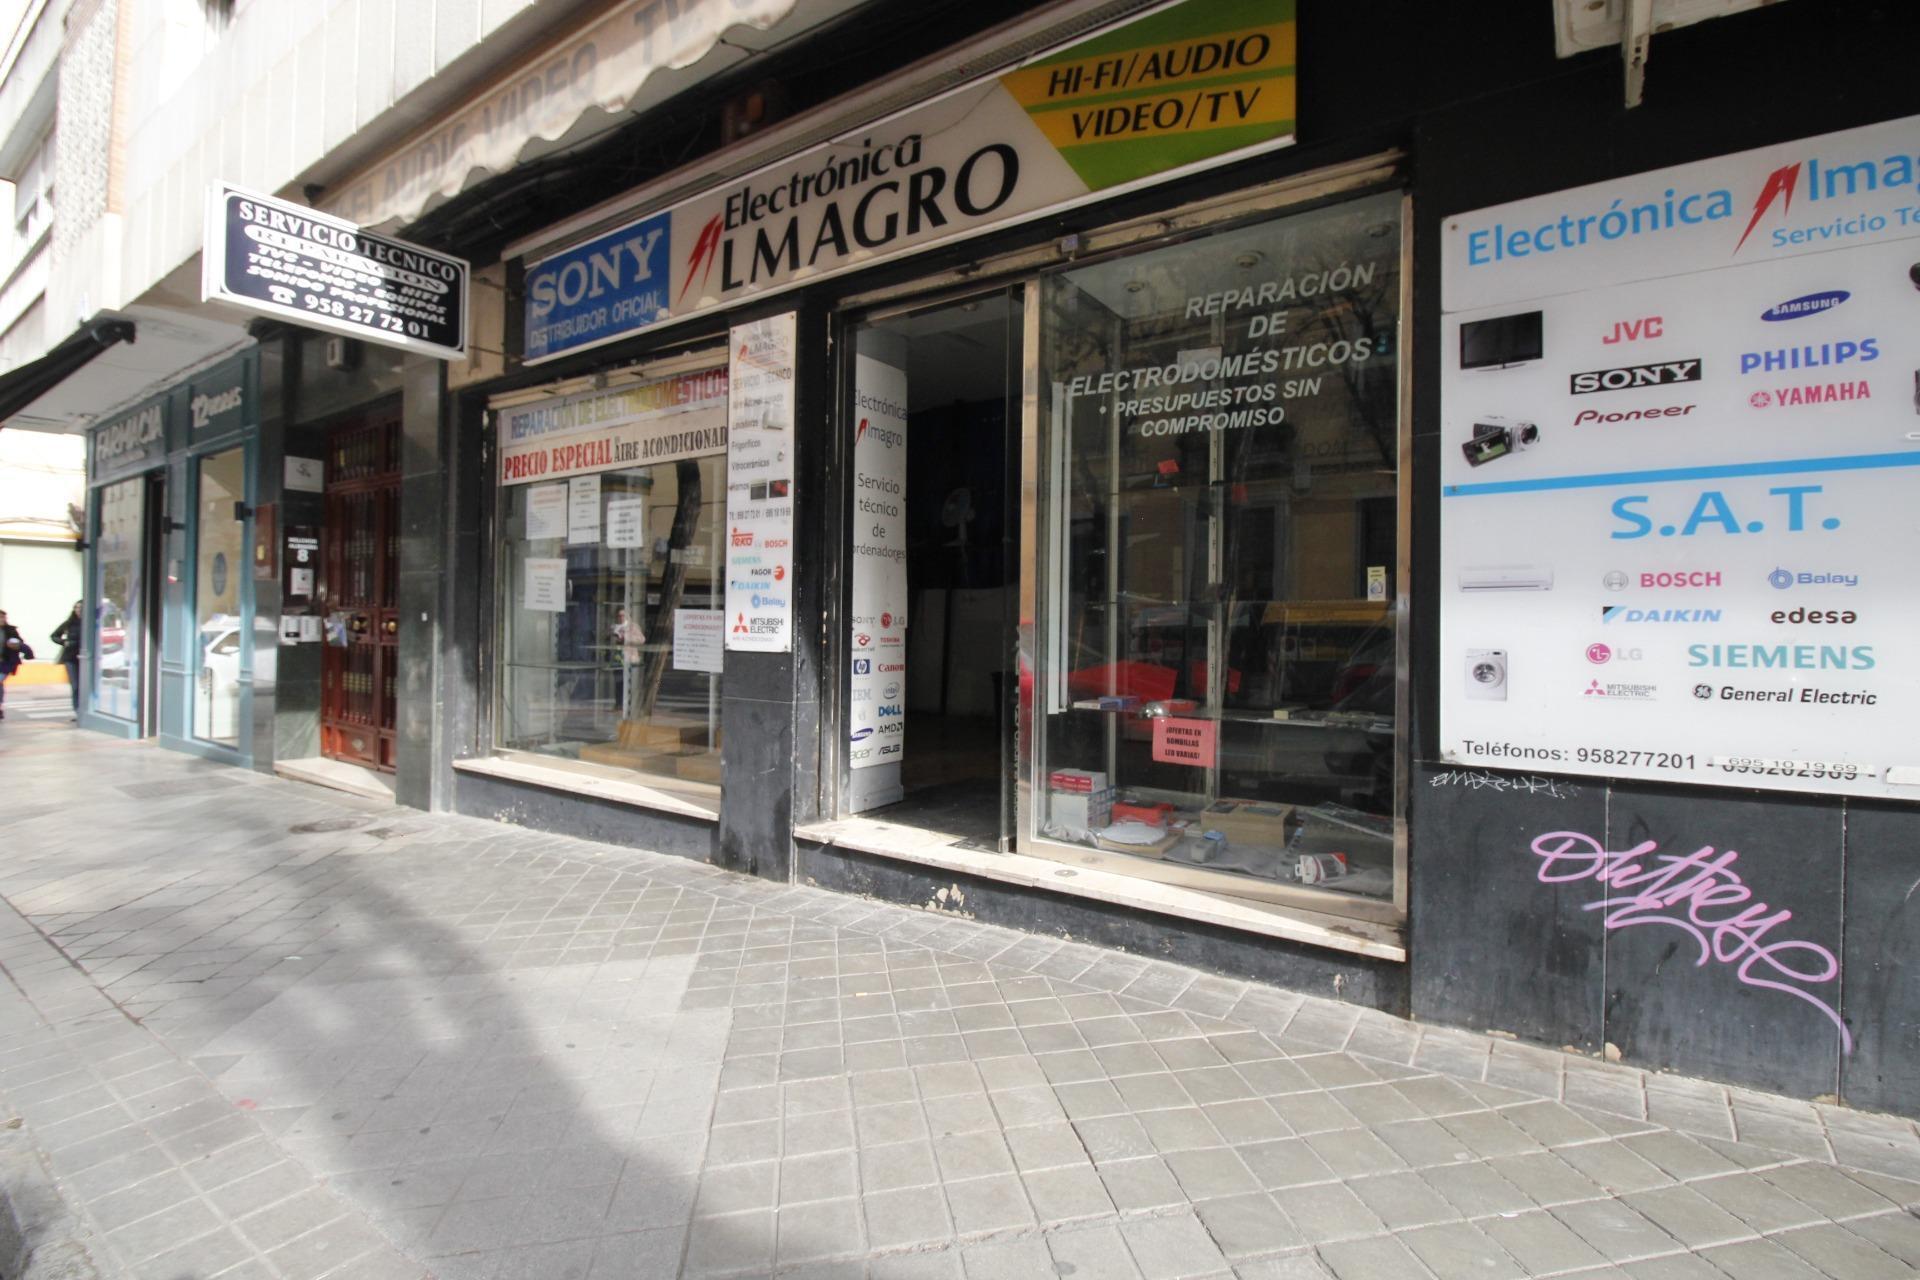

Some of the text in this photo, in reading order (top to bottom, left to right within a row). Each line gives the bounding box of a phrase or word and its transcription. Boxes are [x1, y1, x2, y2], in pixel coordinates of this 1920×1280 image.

[1048, 34, 1270, 97] HI-FI/AUDIO
[1072, 86, 1261, 139] VIDEO/TV
[724, 133, 922, 232] Electrónica
[239, 200, 455, 281] SERVICIO TECNICO
[1468, 188, 1733, 266] Electrónica
[1772, 213, 1886, 248] Servicio
[248, 252, 356, 290] TELEFONOS
[374, 288, 447, 314] EQUIPOS
[320, 262, 381, 286] VIDEO
[401, 286, 439, 302] HIFI
[532, 228, 663, 318] SONY
[246, 265, 447, 325] SONIDO PROFESIONAL
[1185, 262, 1376, 320] REPARACIÓN
[304, 295, 430, 338] 958 27 72 01
[530, 290, 660, 349] DISTRIBUIDOR OFICIAL
[1248, 311, 1288, 338] DE
[1602, 296, 1840, 344] JVC SAMSUNG
[1070, 337, 1373, 397] ELECTRODOMÉSTICOS
[1574, 338, 1880, 393] SONY PHILIPS
[1113, 377, 1322, 417] PRESUPUESTOS SIN
[1573, 381, 1871, 426] Pioneer YAMAHA
[97, 405, 164, 460] FARMACIA
[1140, 406, 1285, 437] COMPROMISO
[504, 451, 548, 480] PRECIO
[552, 438, 612, 472] ESPECIAL
[614, 440, 639, 463] AIRE
[857, 473, 900, 494] Servicio
[859, 498, 898, 517] técnico
[1610, 485, 1841, 539] S.A.T.
[765, 539, 788, 549] BOSCH
[872, 523, 886, 538] de
[751, 568, 772, 577] FAGOR
[1640, 571, 1858, 588] BOSCH Balay
[762, 596, 786, 608] Balay
[1625, 607, 1857, 624] DAIKIN edesa
[750, 617, 784, 627] MITSUBISHI
[750, 625, 779, 634] ELECTRIC
[878, 663, 905, 673] Canon
[1616, 644, 1876, 670] LG SIEMENS
[878, 706, 902, 718] DELL
[1607, 683, 1878, 706] MITSUBISHI General Electric
[878, 723, 896, 734] AMD
[878, 745, 900, 755] ASUS
[1462, 740, 1569, 762] Teléfonos:
[1577, 747, 1696, 770] 958277201
[1728, 757, 1764, 768] 695
[1774, 759, 1794, 769] 10
[1805, 761, 1826, 771] 19
